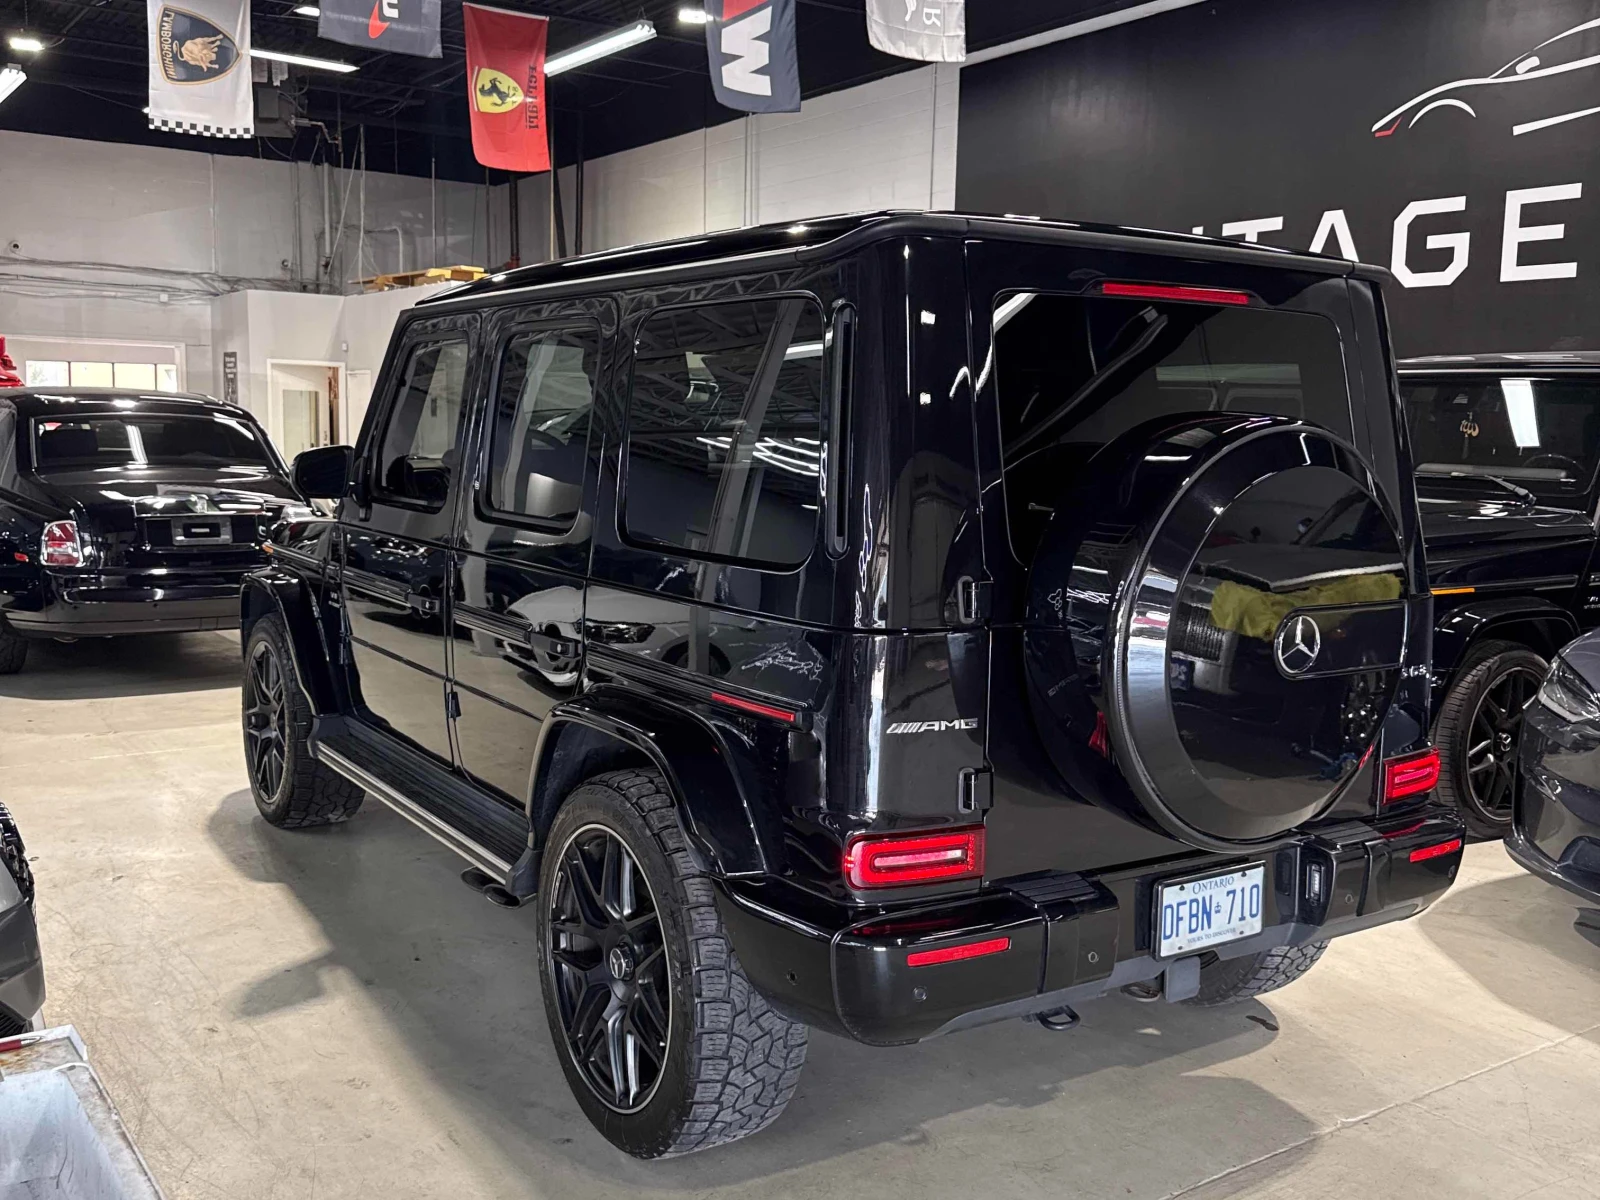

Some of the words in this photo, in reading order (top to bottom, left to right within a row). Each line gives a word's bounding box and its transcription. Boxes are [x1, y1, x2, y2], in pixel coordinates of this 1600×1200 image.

[1192, 183, 1582, 288] TAGE
[918, 718, 978, 732] AMG
[1192, 876, 1235, 894] ONTARIO
[1163, 895, 1213, 940] DFBN
[1226, 884, 1260, 924] 710
